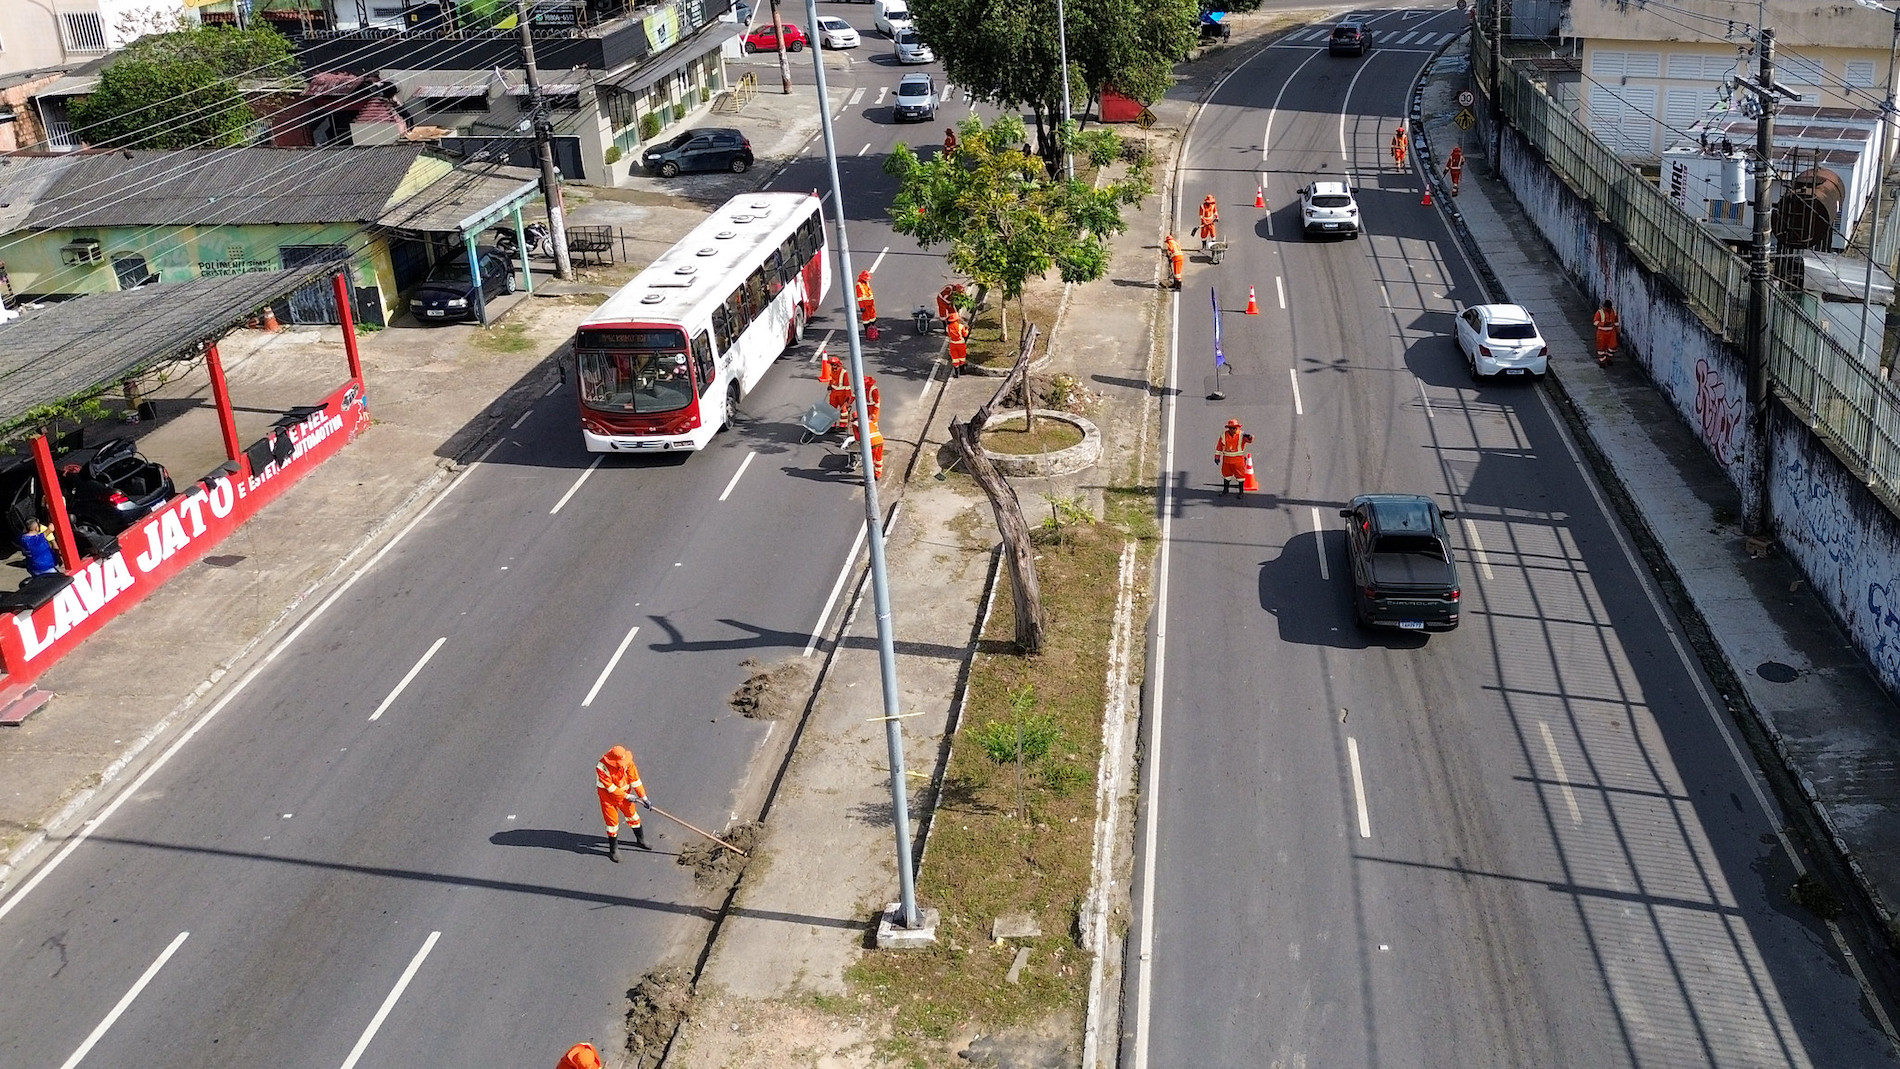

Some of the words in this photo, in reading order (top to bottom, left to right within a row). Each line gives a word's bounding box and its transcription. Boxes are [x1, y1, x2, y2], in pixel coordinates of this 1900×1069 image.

[1461, 94, 1472, 102] 30
[237, 481, 247, 499] E
[13, 551, 136, 662] LAVA
[137, 476, 234, 573] JATO
